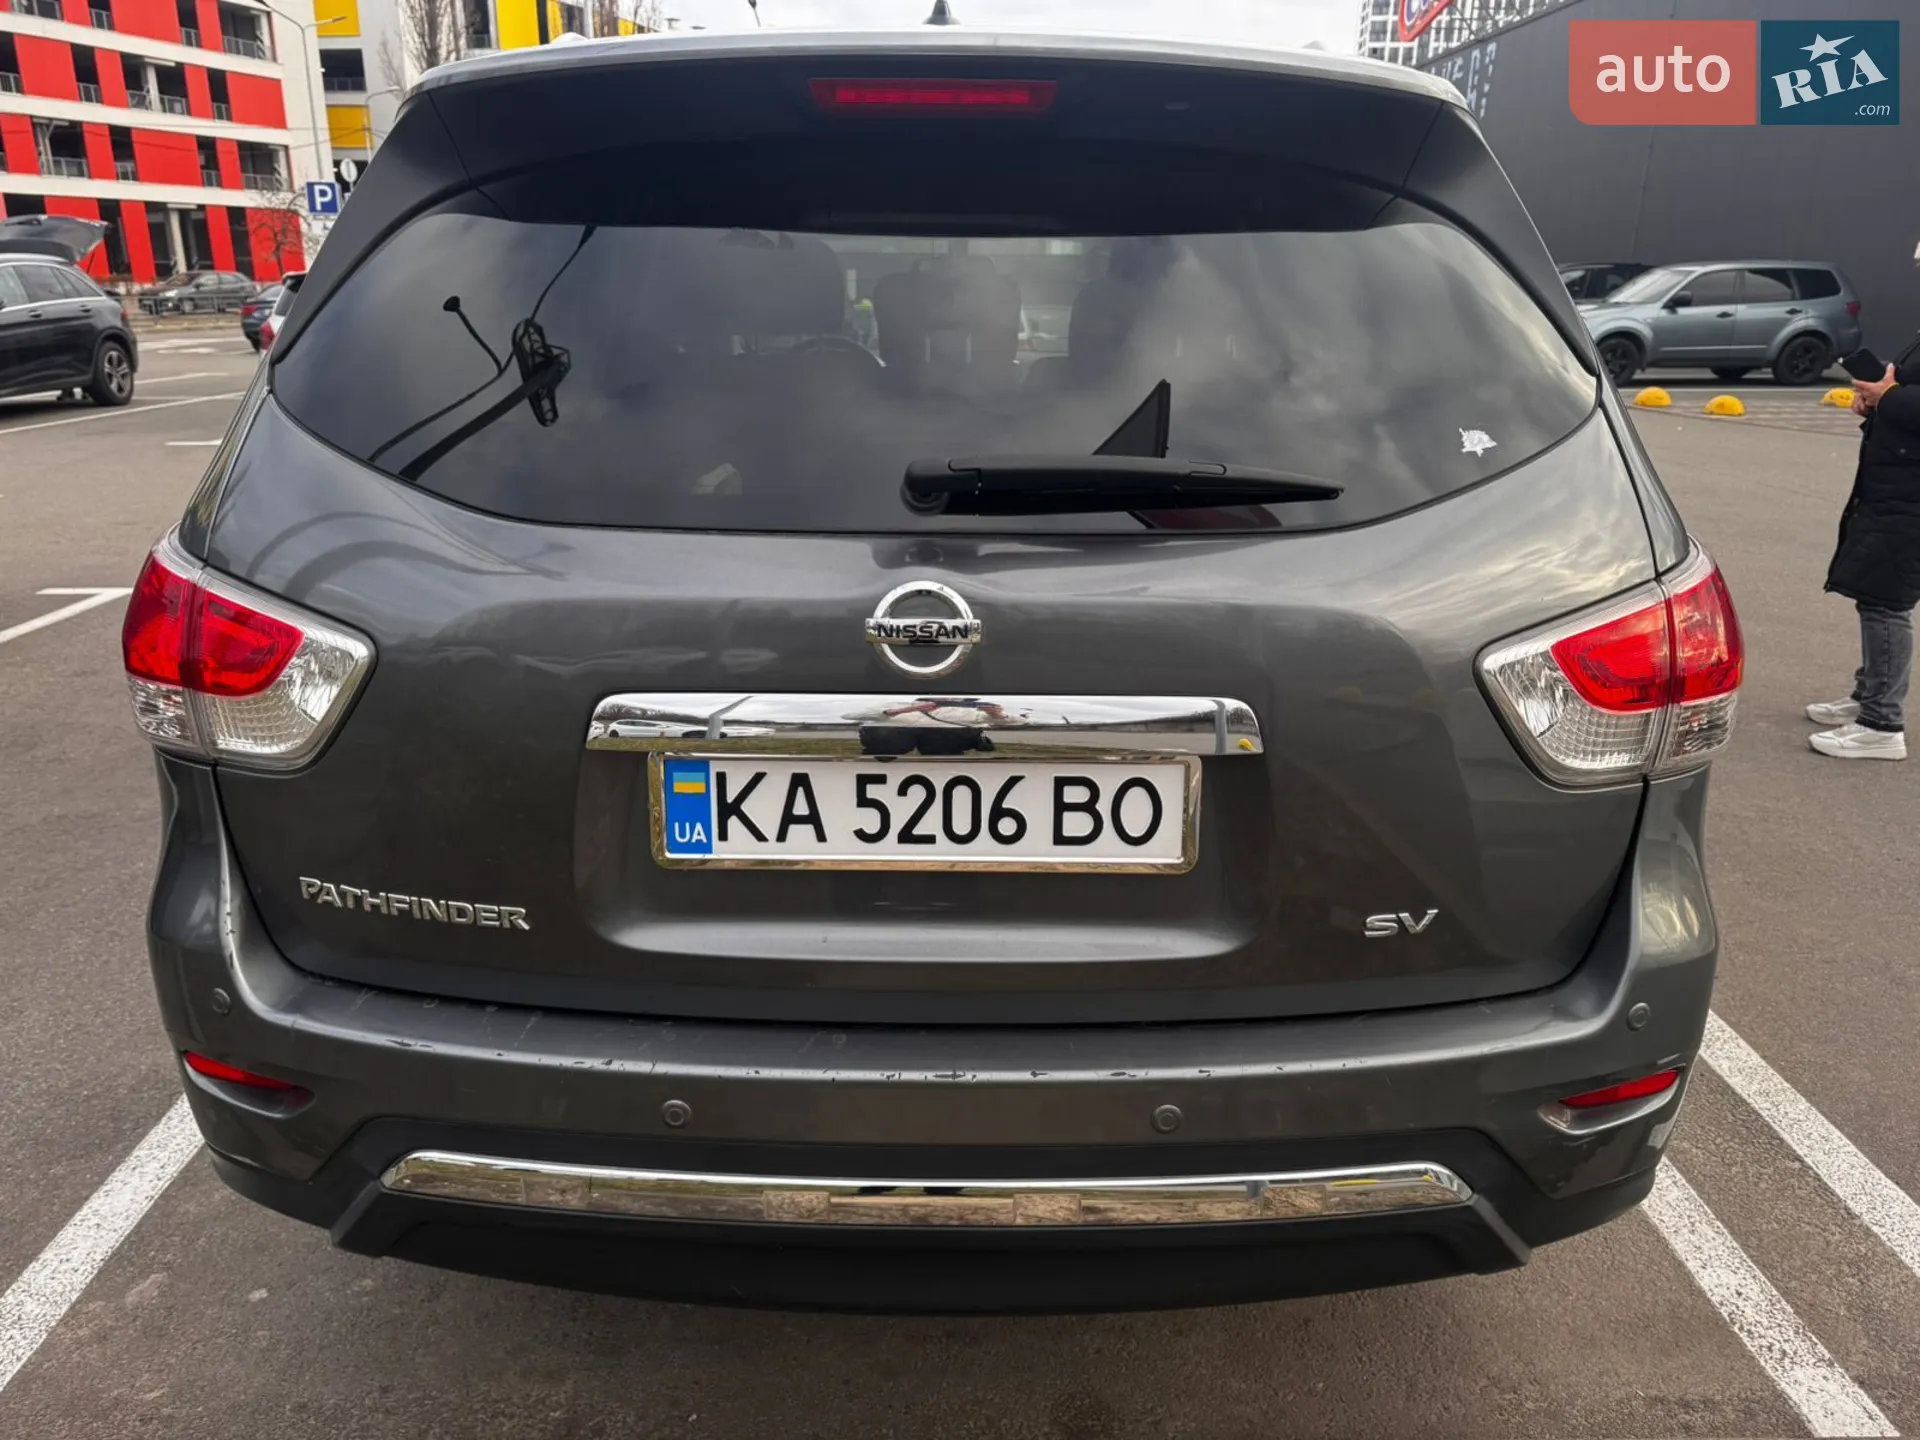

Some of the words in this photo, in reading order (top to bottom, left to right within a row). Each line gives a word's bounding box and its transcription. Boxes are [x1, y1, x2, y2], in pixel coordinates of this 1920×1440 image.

[313, 184, 333, 211] P
[876, 624, 969, 639] NISSAN
[715, 771, 828, 843] KA
[852, 773, 1028, 846] 5206
[1053, 776, 1163, 847] BO
[674, 822, 707, 844] UA
[299, 876, 531, 931] PATHFINDER
[1363, 908, 1439, 938] SV
